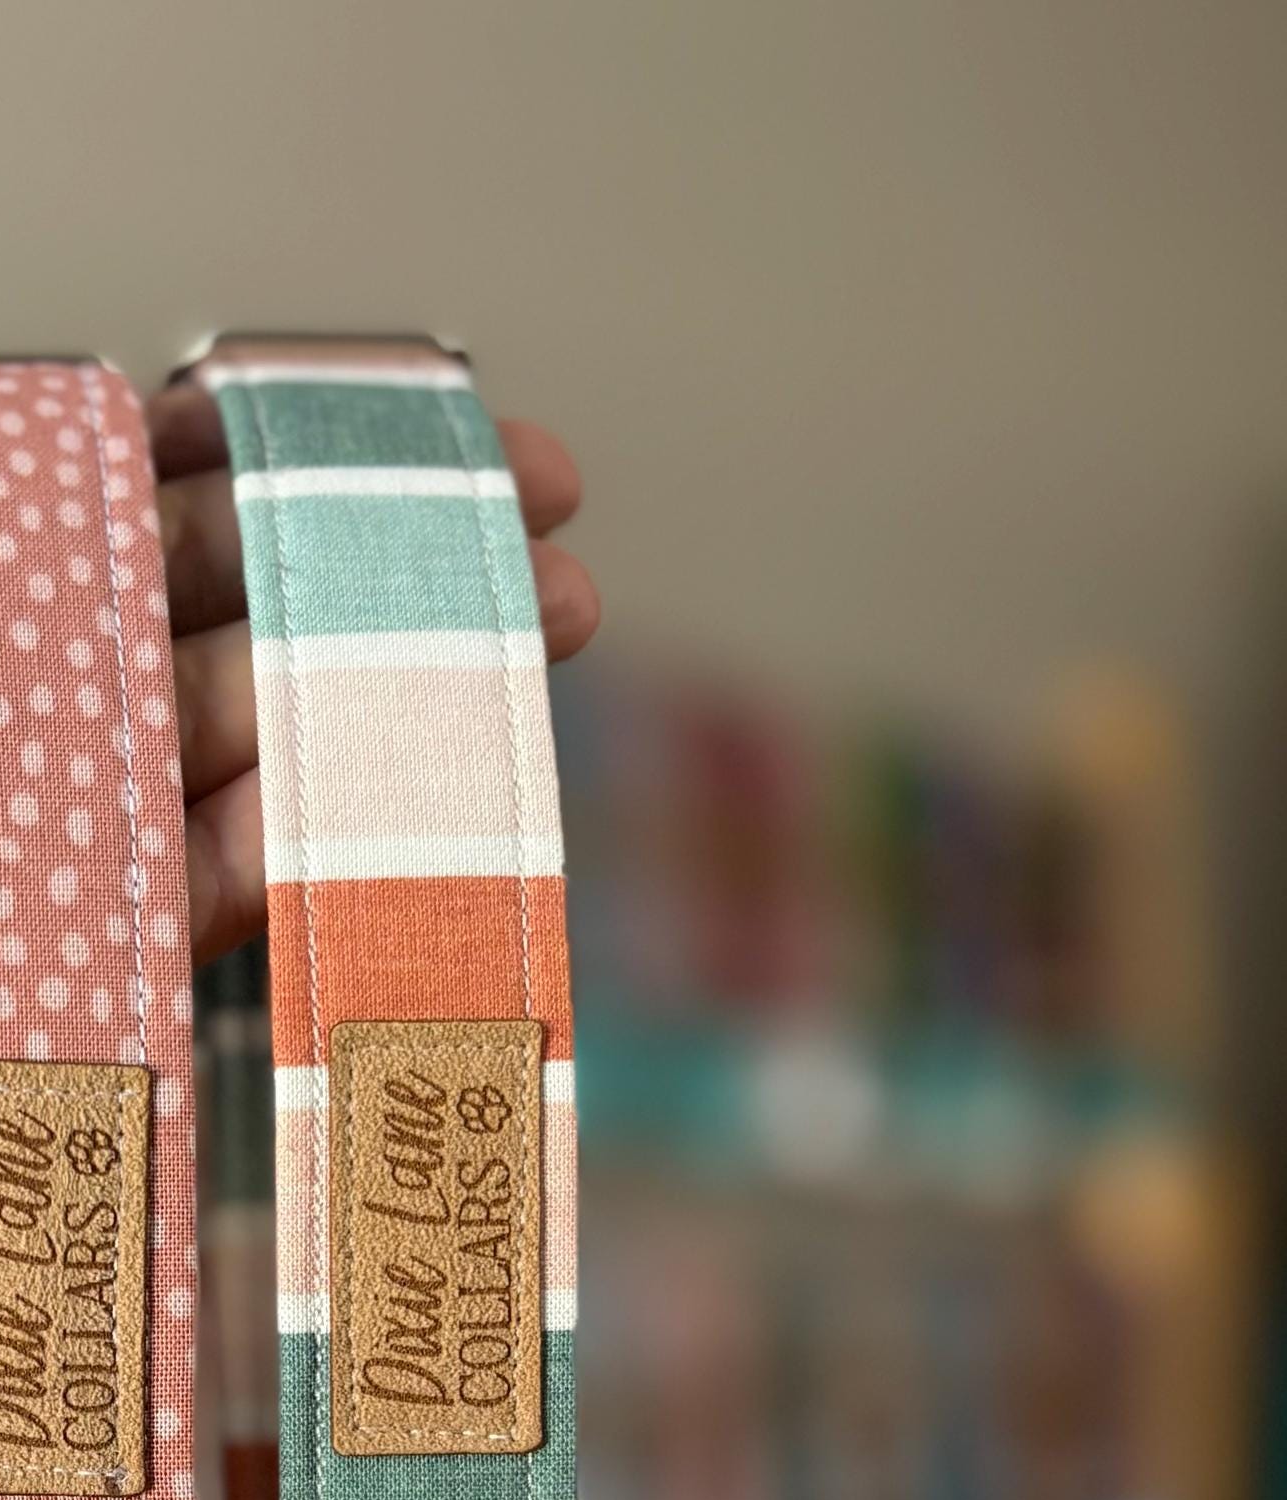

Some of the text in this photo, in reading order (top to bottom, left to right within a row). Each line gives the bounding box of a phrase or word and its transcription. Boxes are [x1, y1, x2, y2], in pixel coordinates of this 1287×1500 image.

[62, 1201, 118, 1452] COLLARS
[360, 1069, 455, 1407] Dixie Lane
[457, 1157, 512, 1409] COLLARS
